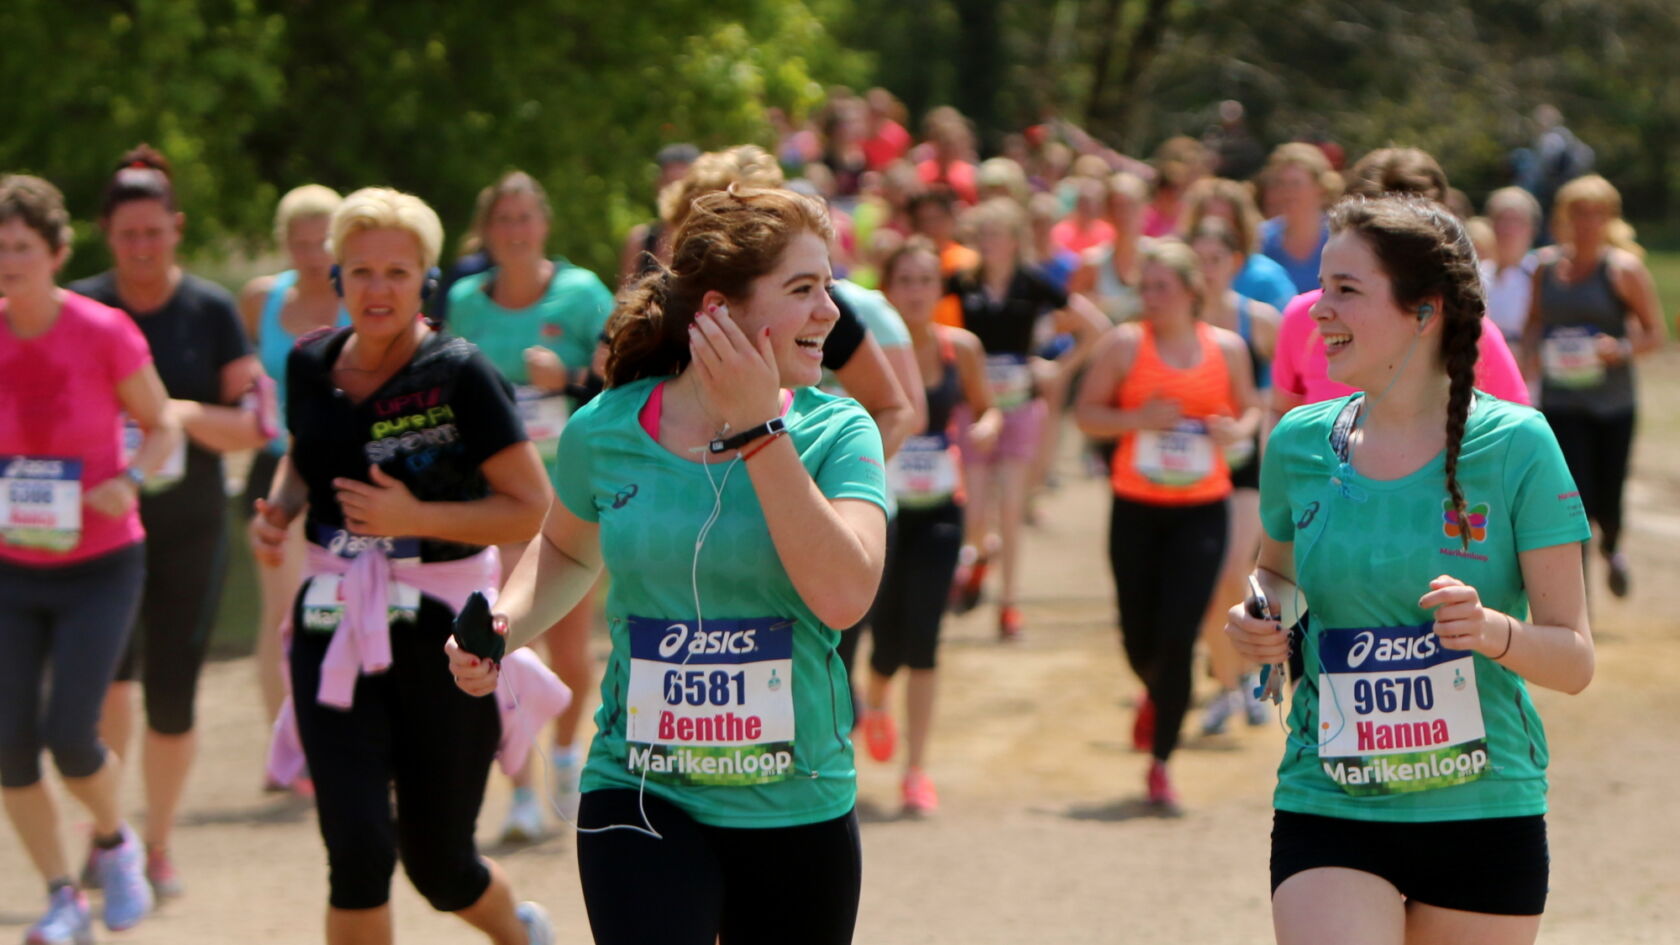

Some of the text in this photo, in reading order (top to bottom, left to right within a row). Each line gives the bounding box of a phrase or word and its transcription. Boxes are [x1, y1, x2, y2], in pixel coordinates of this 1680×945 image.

[663, 669, 746, 707] 6581
[1353, 675, 1434, 715] 9670
[658, 710, 762, 742] Benthe
[1356, 718, 1450, 752] Hanna
[628, 746, 792, 775] Marikenloop
[1323, 749, 1487, 785] Marikenloop
